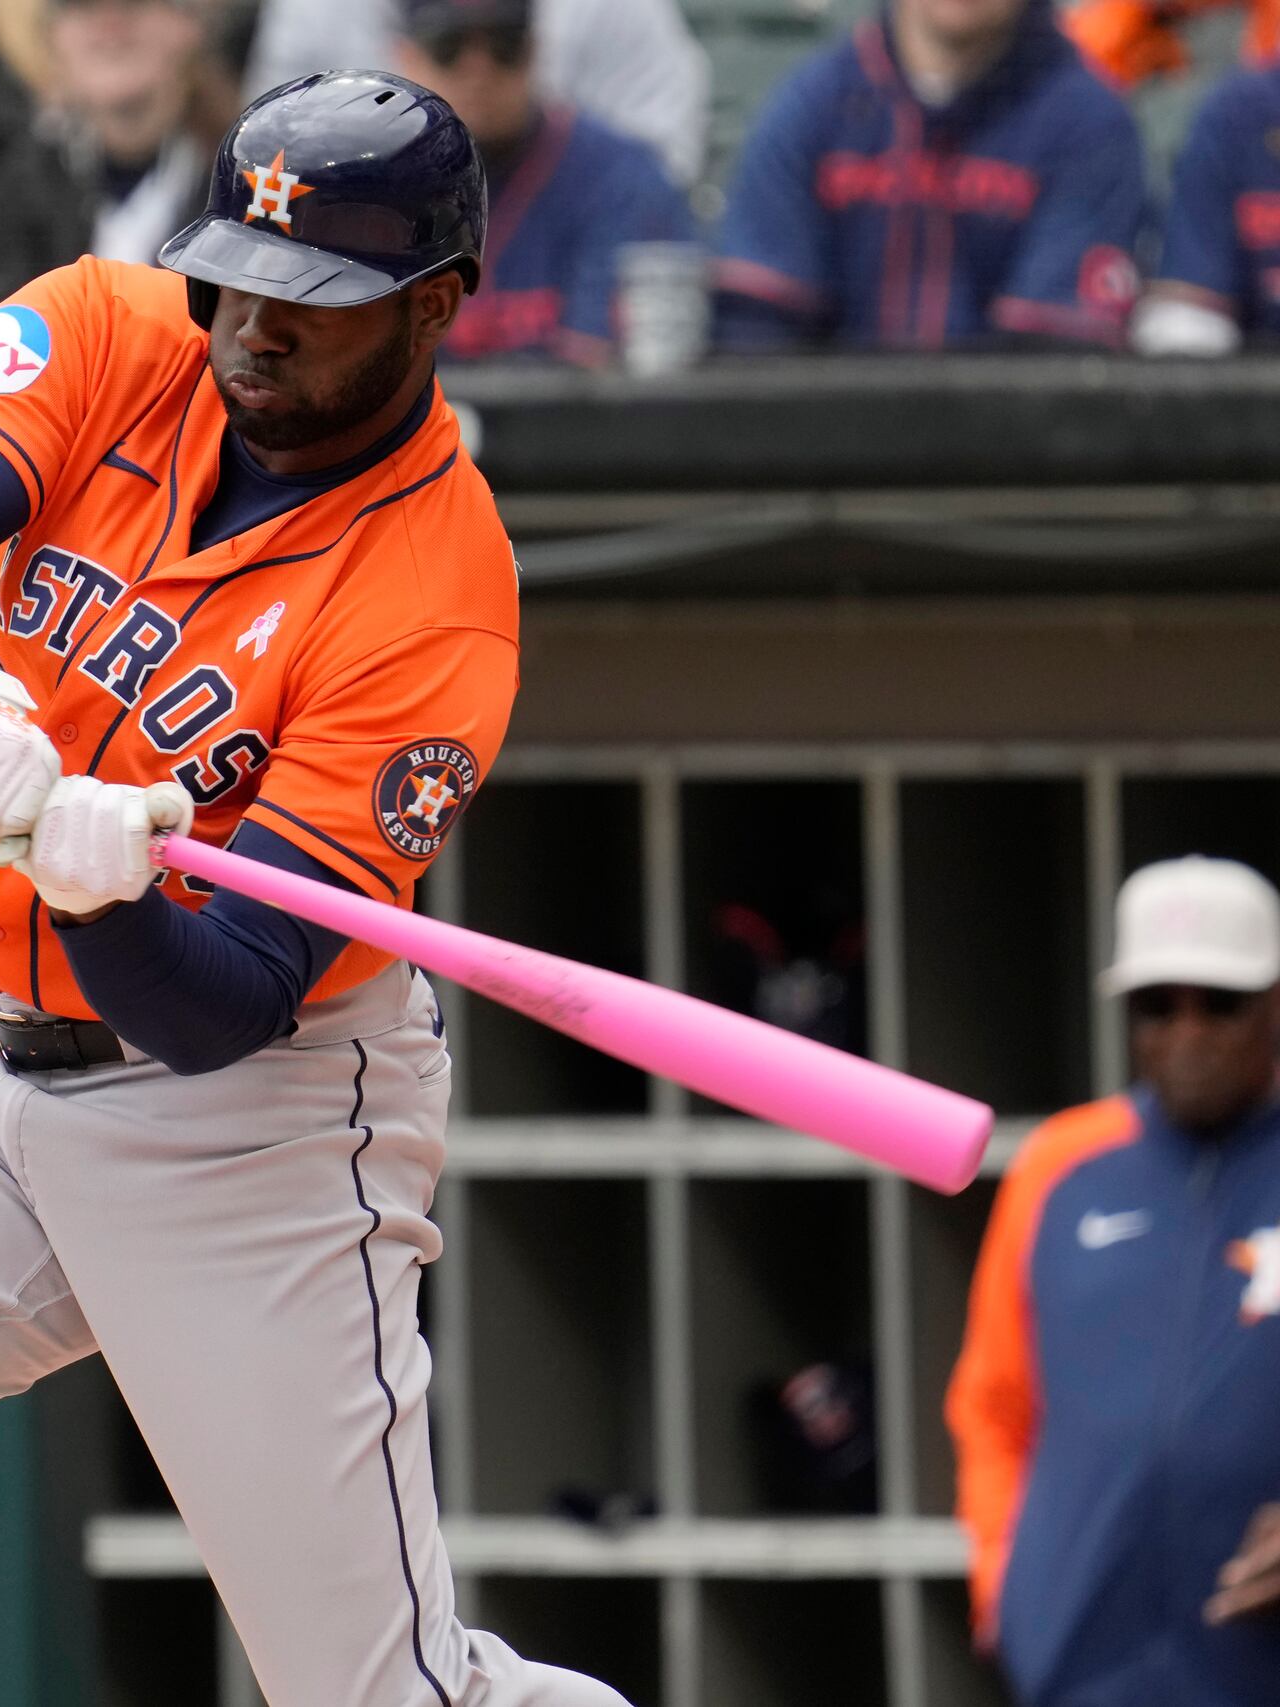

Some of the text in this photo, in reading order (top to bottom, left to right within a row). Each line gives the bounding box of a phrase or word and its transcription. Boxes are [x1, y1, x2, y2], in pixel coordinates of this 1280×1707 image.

[247, 165, 299, 224] H
[408, 746, 474, 794] HOUSTON
[406, 774, 455, 827] H
[382, 811, 440, 853] ASTROS
